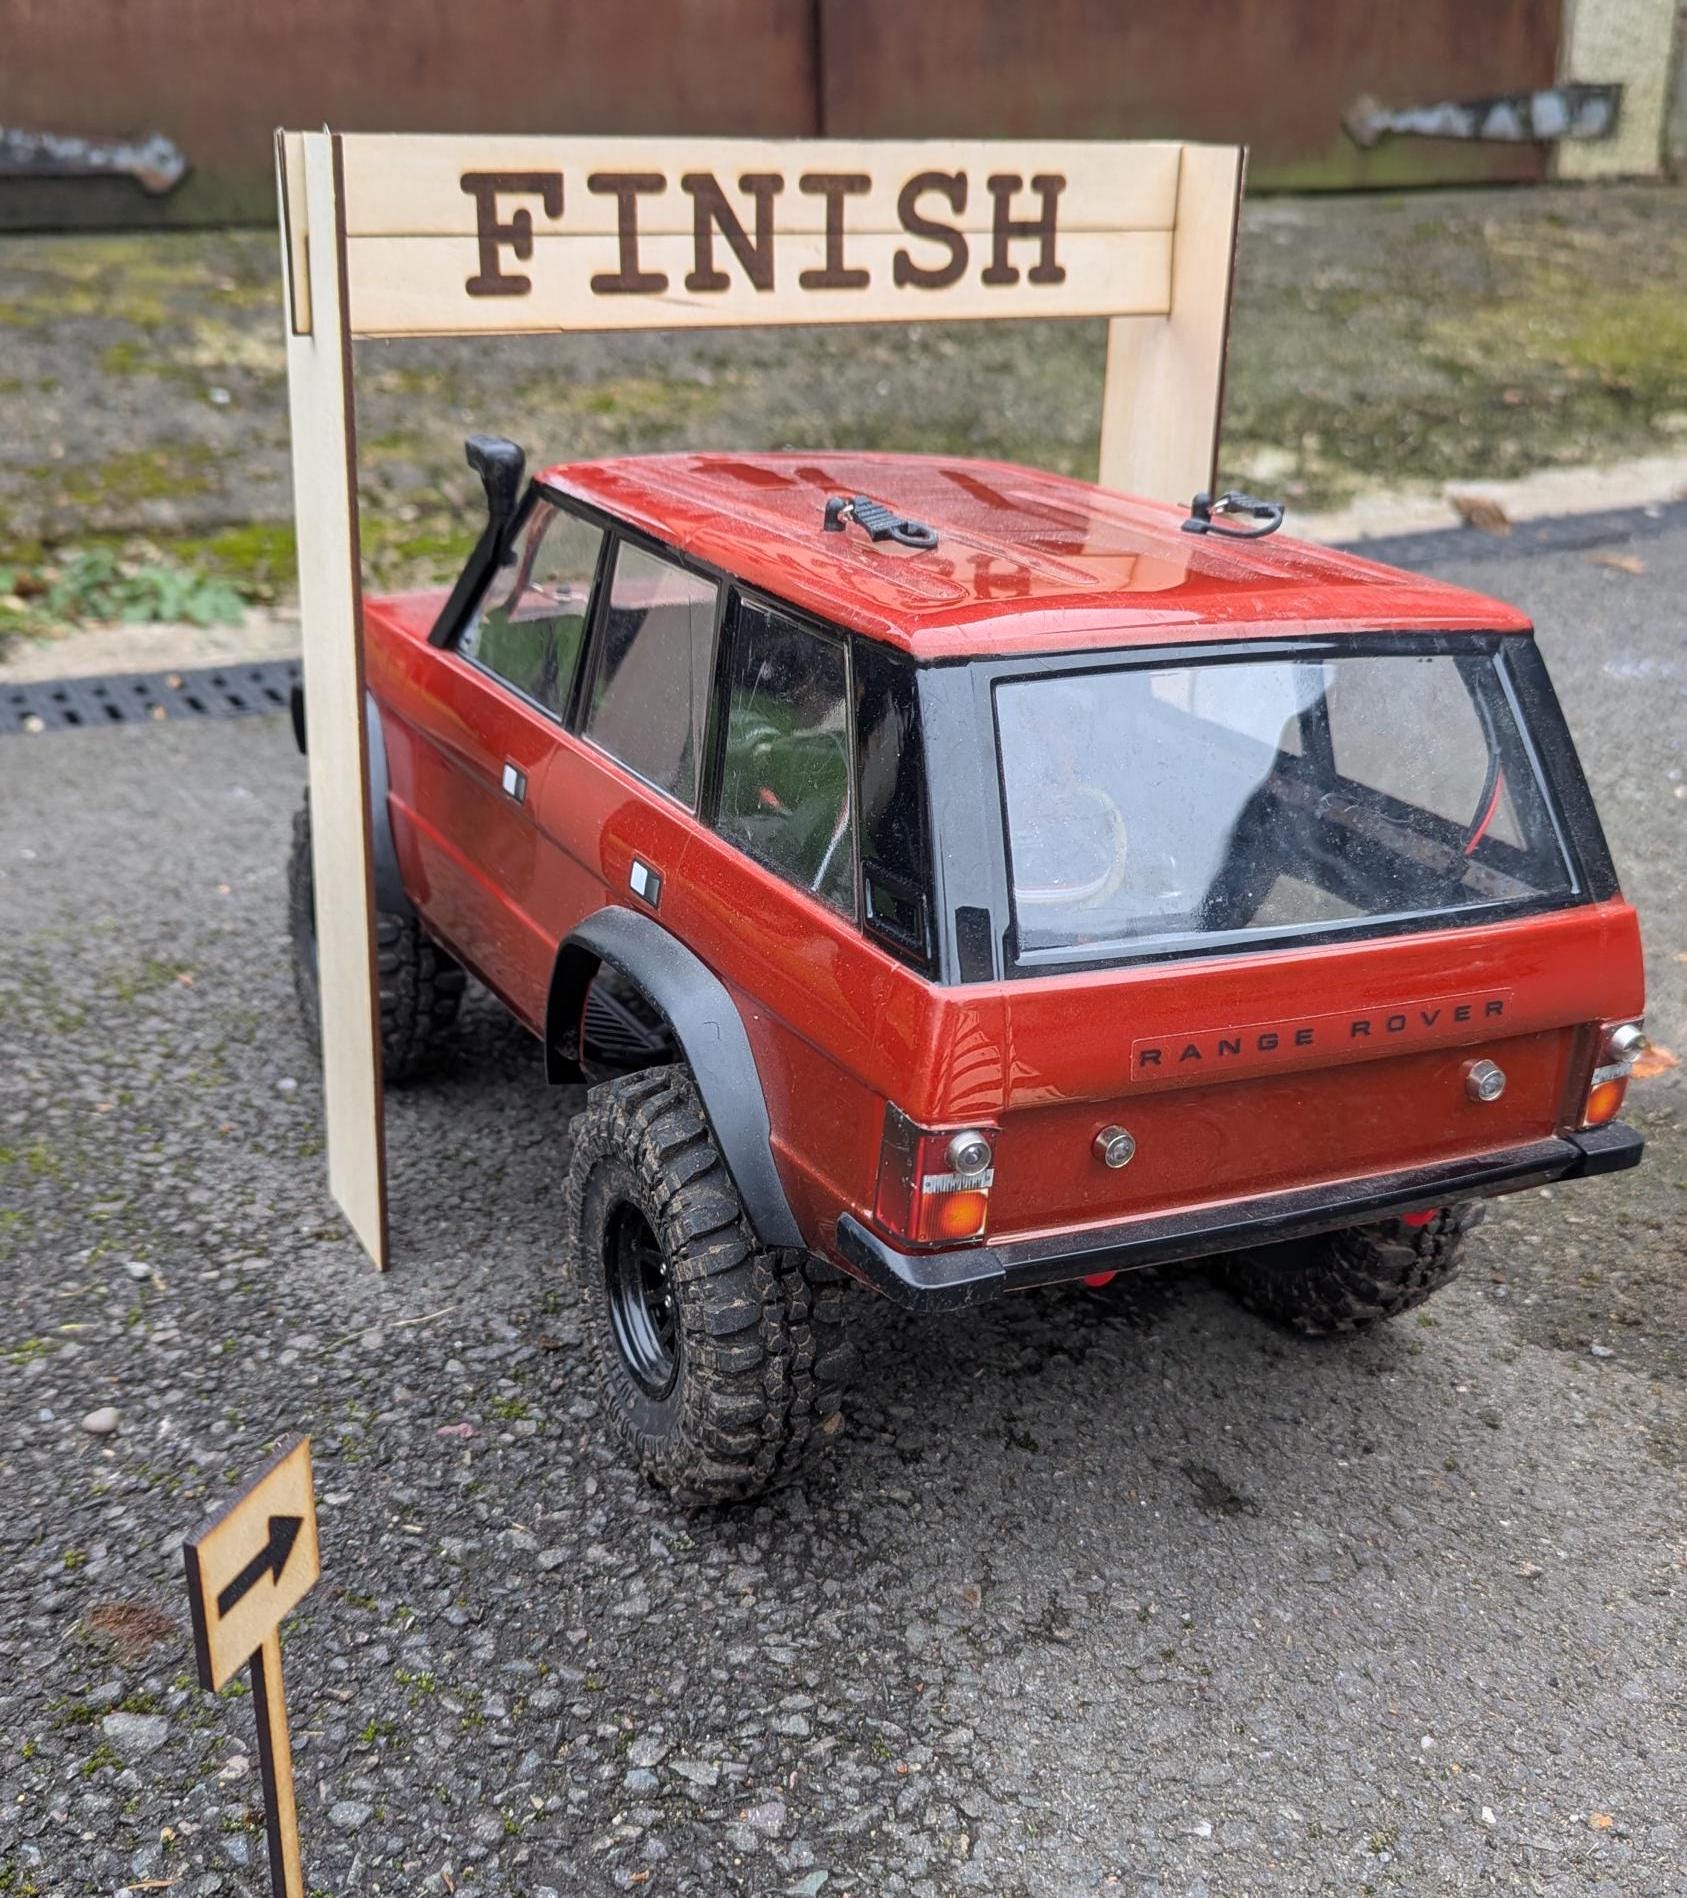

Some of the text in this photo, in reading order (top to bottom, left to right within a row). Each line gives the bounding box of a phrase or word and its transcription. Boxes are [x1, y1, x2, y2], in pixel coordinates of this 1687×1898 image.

[460, 171, 1067, 297] FINISH
[1139, 1000, 1505, 1068] RANGE ROVER
